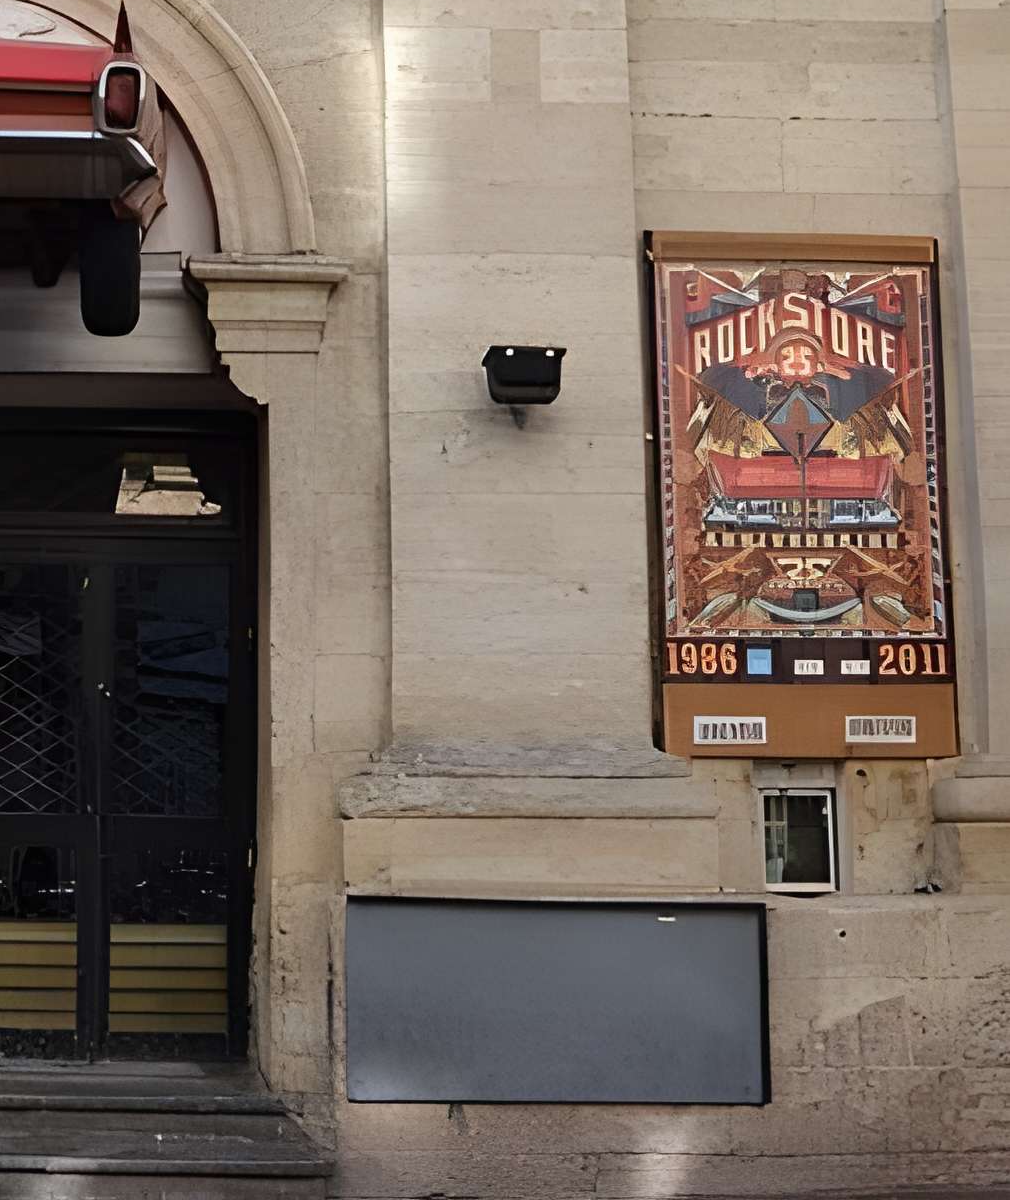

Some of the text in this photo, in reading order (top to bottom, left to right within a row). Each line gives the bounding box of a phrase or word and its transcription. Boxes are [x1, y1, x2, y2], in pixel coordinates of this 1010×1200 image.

[694, 292, 895, 374] ROCKSTORE
[666, 642, 737, 675] 1986
[879, 643, 947, 676] 2011
